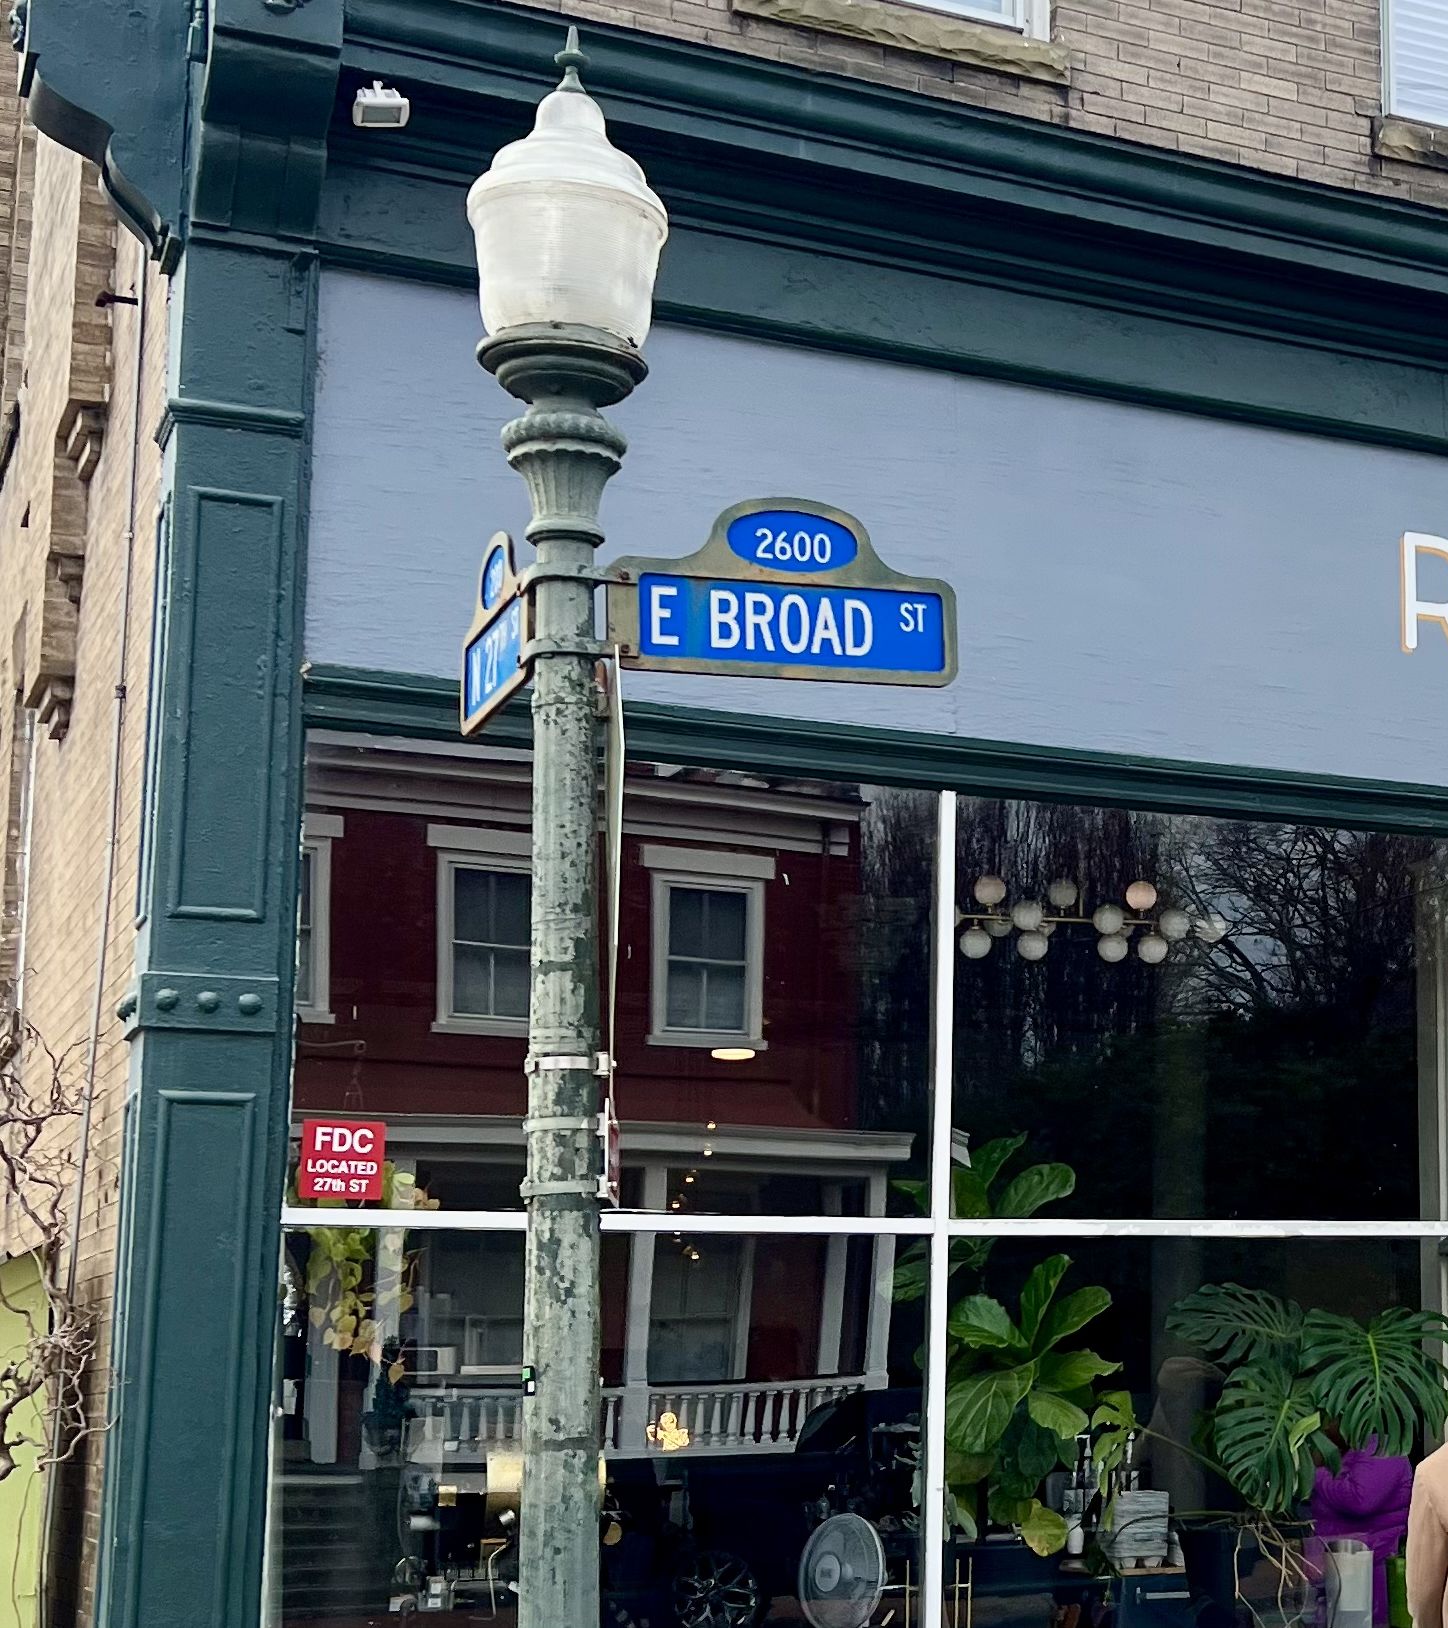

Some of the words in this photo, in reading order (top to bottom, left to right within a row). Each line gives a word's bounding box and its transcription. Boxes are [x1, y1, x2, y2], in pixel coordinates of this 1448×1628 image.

[756, 528, 831, 564] 2600
[651, 586, 679, 645] E
[710, 590, 873, 657] BROAD
[899, 602, 927, 633] ST
[471, 648, 481, 706] N
[314, 1126, 374, 1153] FDC
[306, 1158, 378, 1175] LOCATED
[313, 1177, 346, 1192] 27th
[348, 1178, 369, 1193] ST
